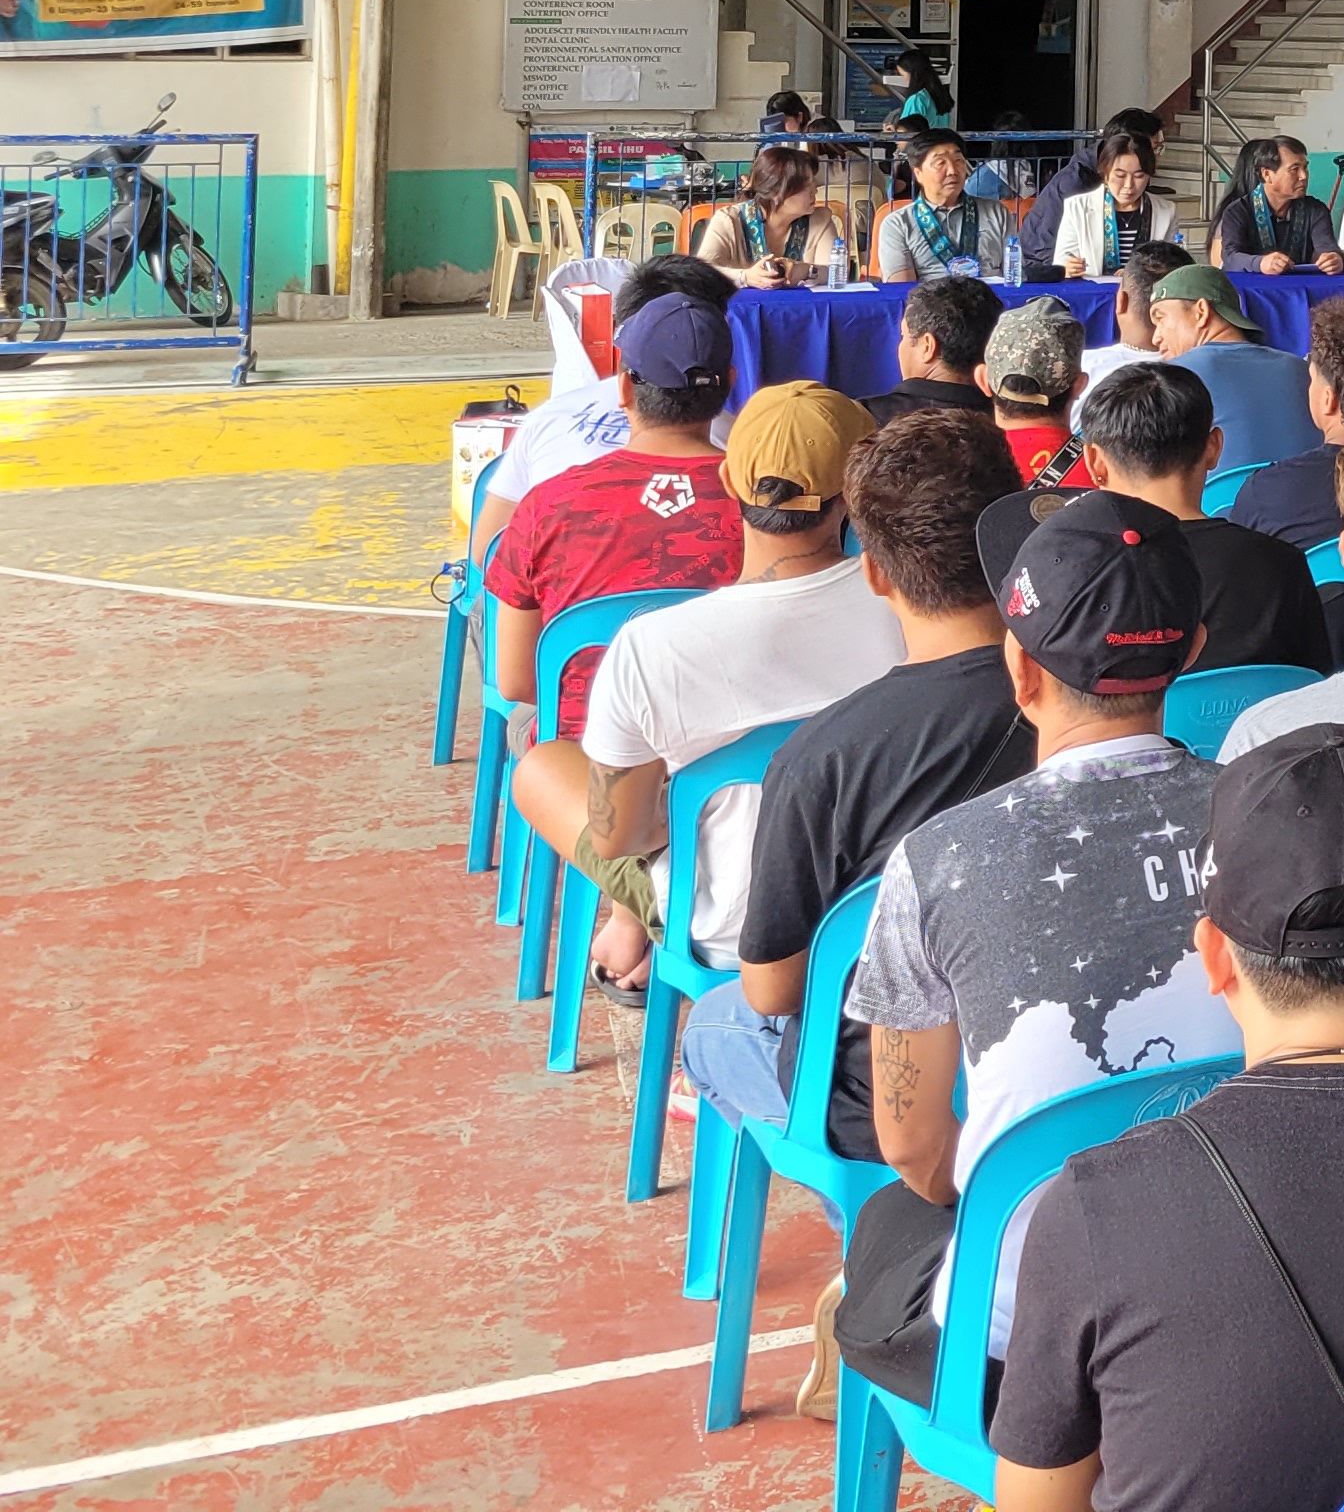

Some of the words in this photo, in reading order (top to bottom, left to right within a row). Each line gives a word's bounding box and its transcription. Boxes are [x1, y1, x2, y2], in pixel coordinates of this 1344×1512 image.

[523, 0, 584, 8] CONFERENCE
[585, 1, 615, 9] ROOM
[523, 9, 576, 17] NUTRITION
[577, 10, 609, 18] OFFICE
[576, 28, 617, 36] FRIENDLY
[652, 28, 689, 36] FACILITY
[523, 46, 599, 54] ENVIRONMENTAL
[600, 46, 653, 54] SANITATION
[654, 46, 682, 54] OFFICE
[523, 55, 576, 63] PROVINCIAL
[578, 55, 632, 63] POPULATION
[633, 55, 662, 63] OFFICE
[522, 74, 558, 82] MSWDO
[539, 83, 569, 91] OFFICE
[522, 93, 564, 101] COMELEC
[521, 102, 542, 110] COA
[568, 145, 615, 155] PAGIL
